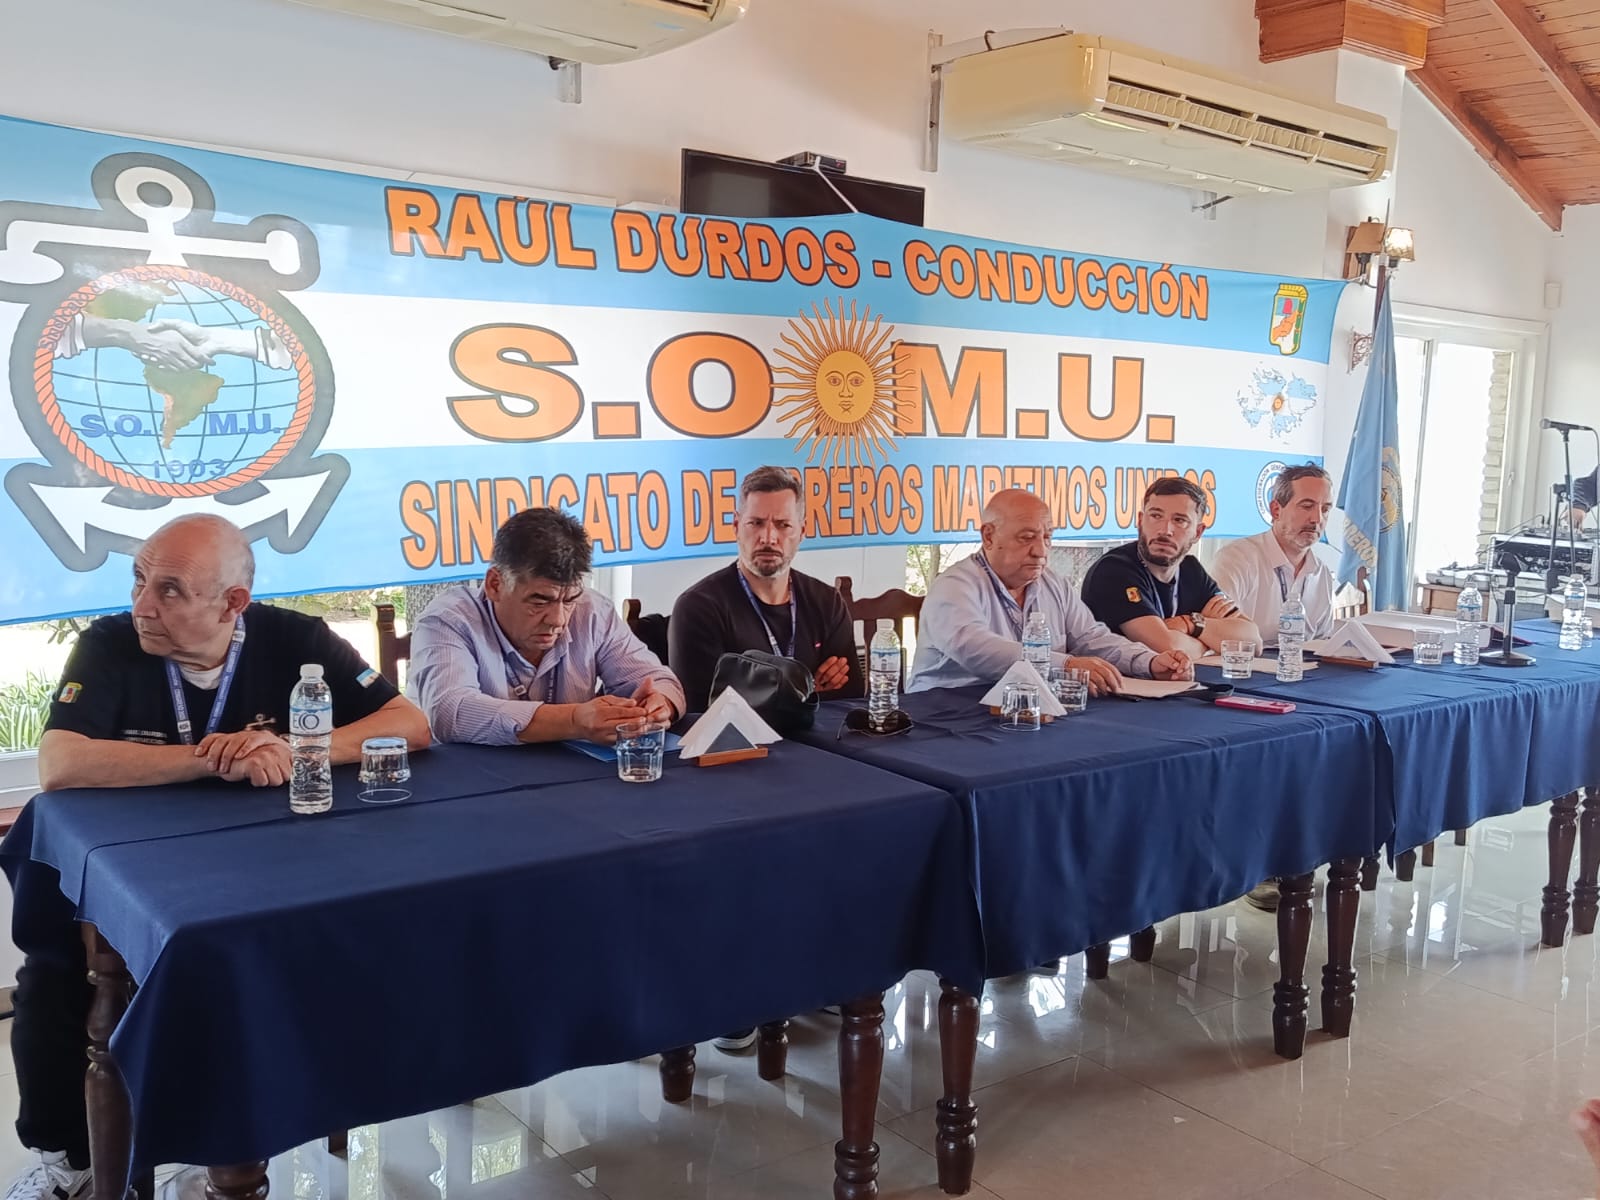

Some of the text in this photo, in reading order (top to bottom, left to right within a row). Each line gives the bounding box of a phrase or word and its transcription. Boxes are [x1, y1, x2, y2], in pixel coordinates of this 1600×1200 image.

[384, 186, 598, 270] RAÚL
[612, 209, 861, 289] DURDOS
[903, 239, 1209, 320] CONDUCCIÓN
[150, 458, 227, 479] 1903
[681, 469, 738, 546] DE
[786, 463, 924, 538] REROS
